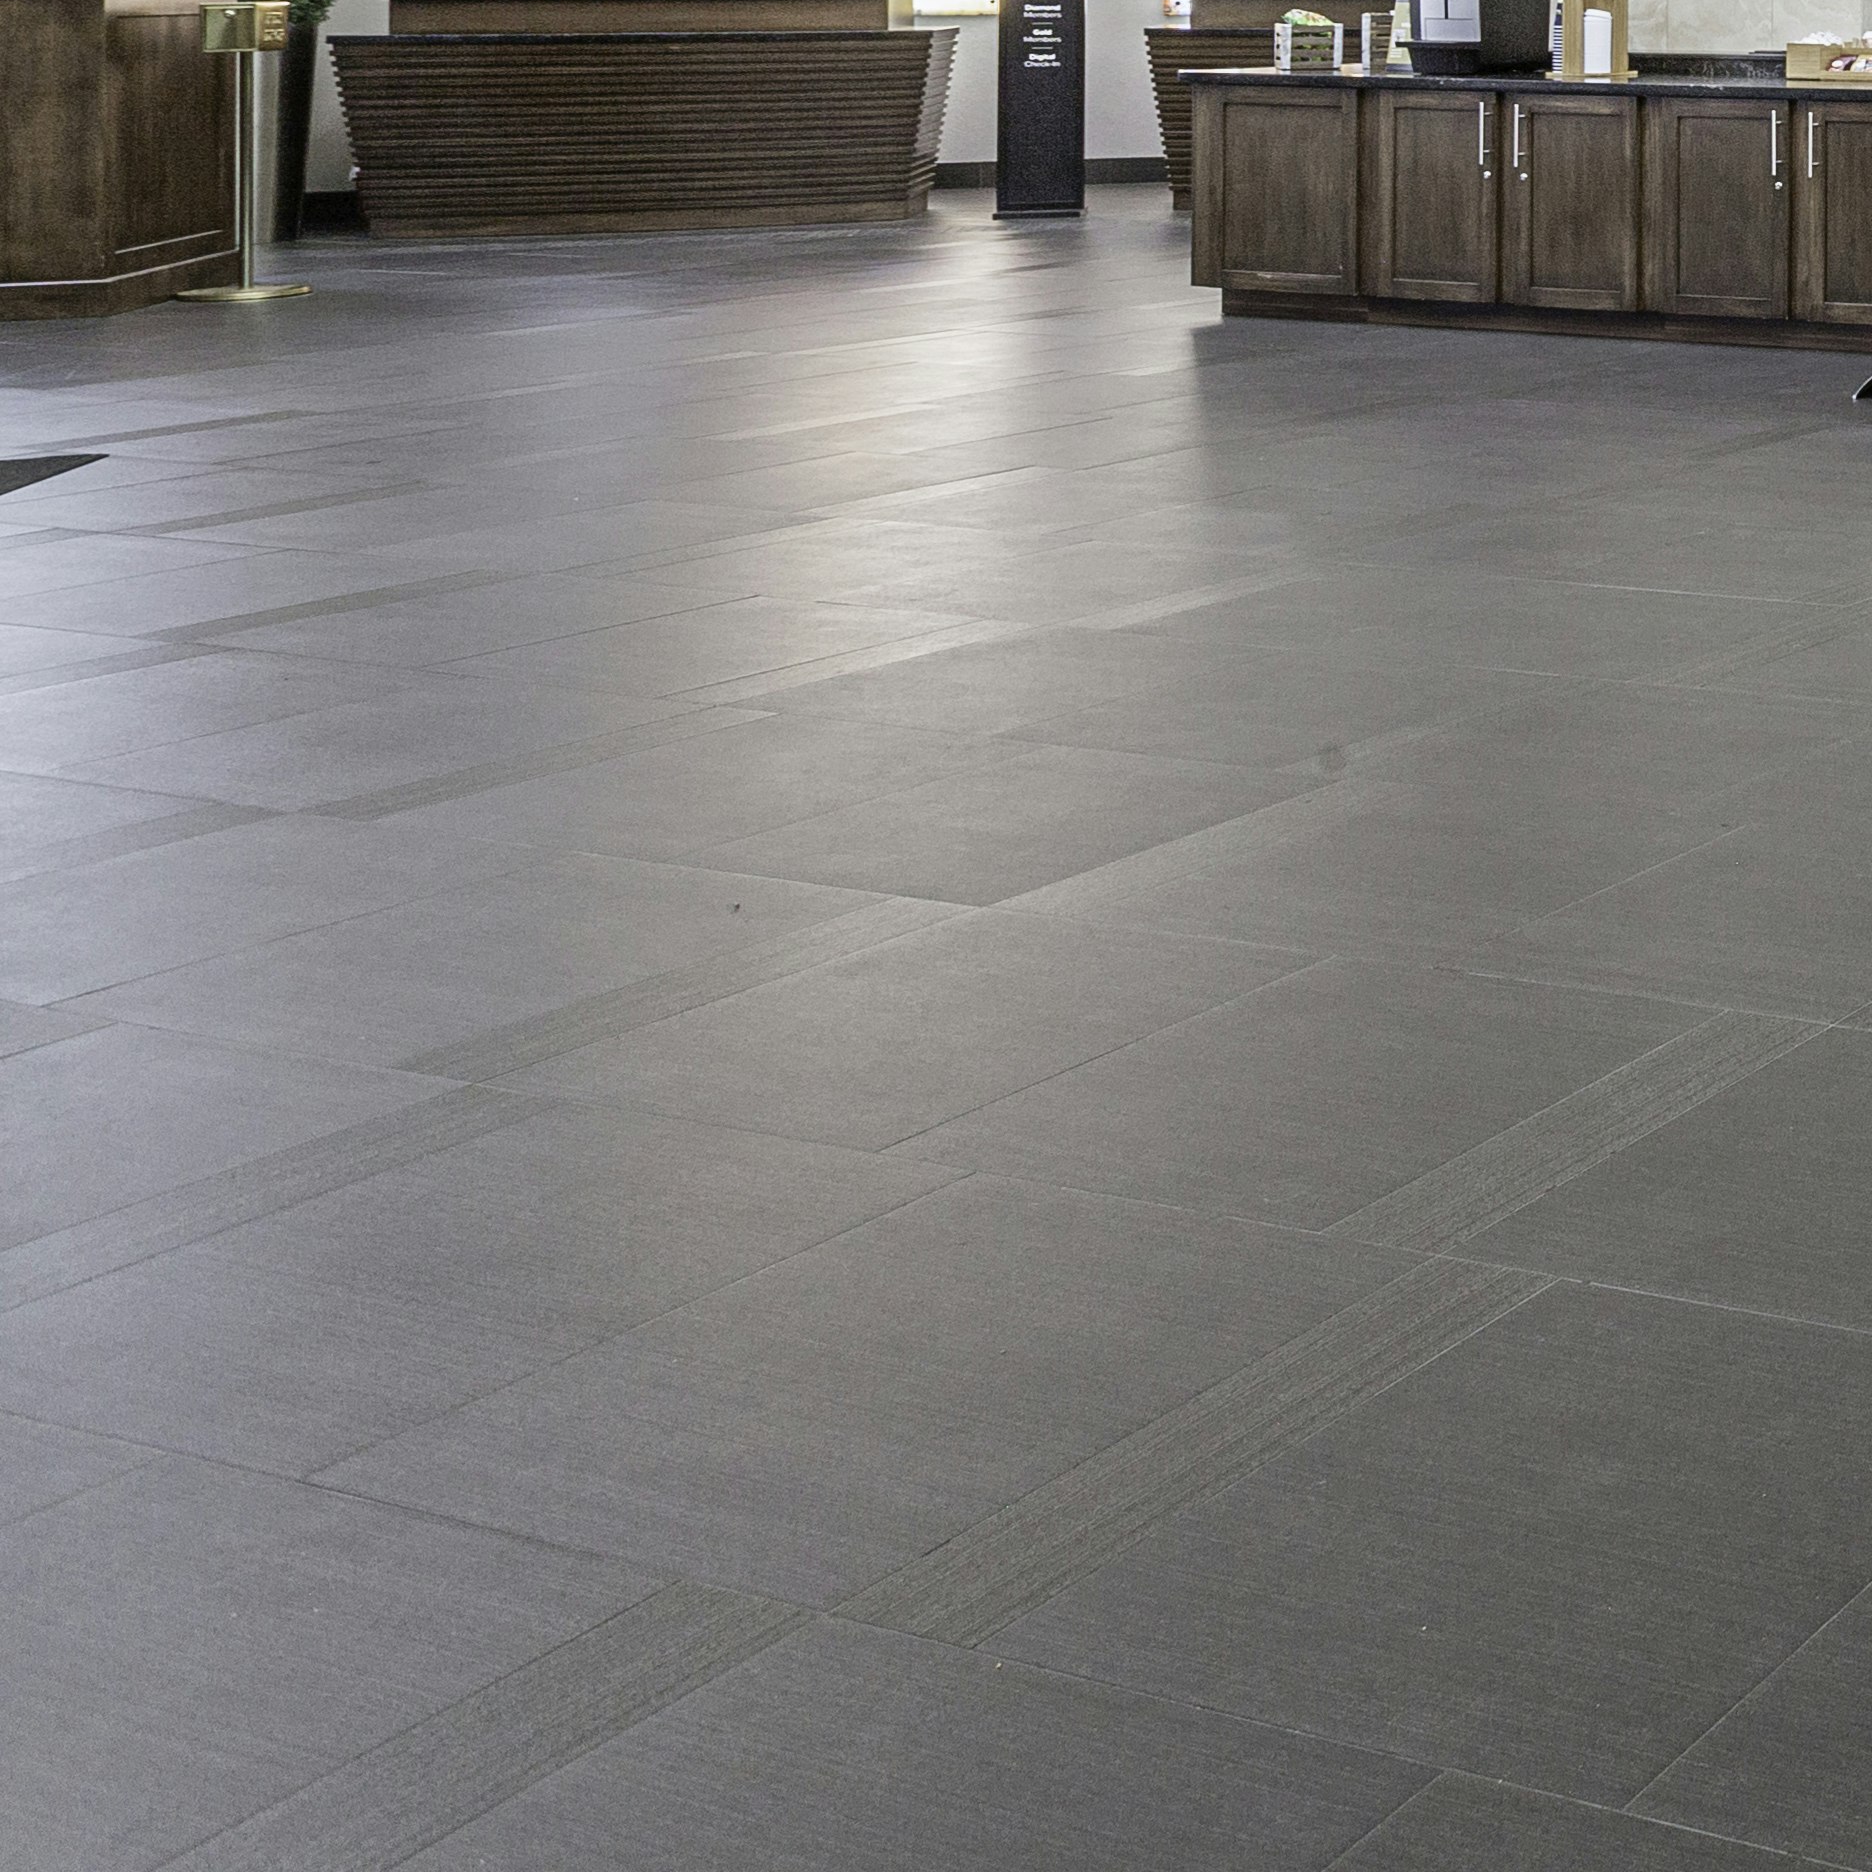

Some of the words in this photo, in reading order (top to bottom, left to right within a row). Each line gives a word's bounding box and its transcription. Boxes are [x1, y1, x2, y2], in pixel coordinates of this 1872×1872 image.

[1023, 11, 1063, 19] Members
[1032, 28, 1054, 36] Gold
[1029, 53, 1056, 62] Digital
